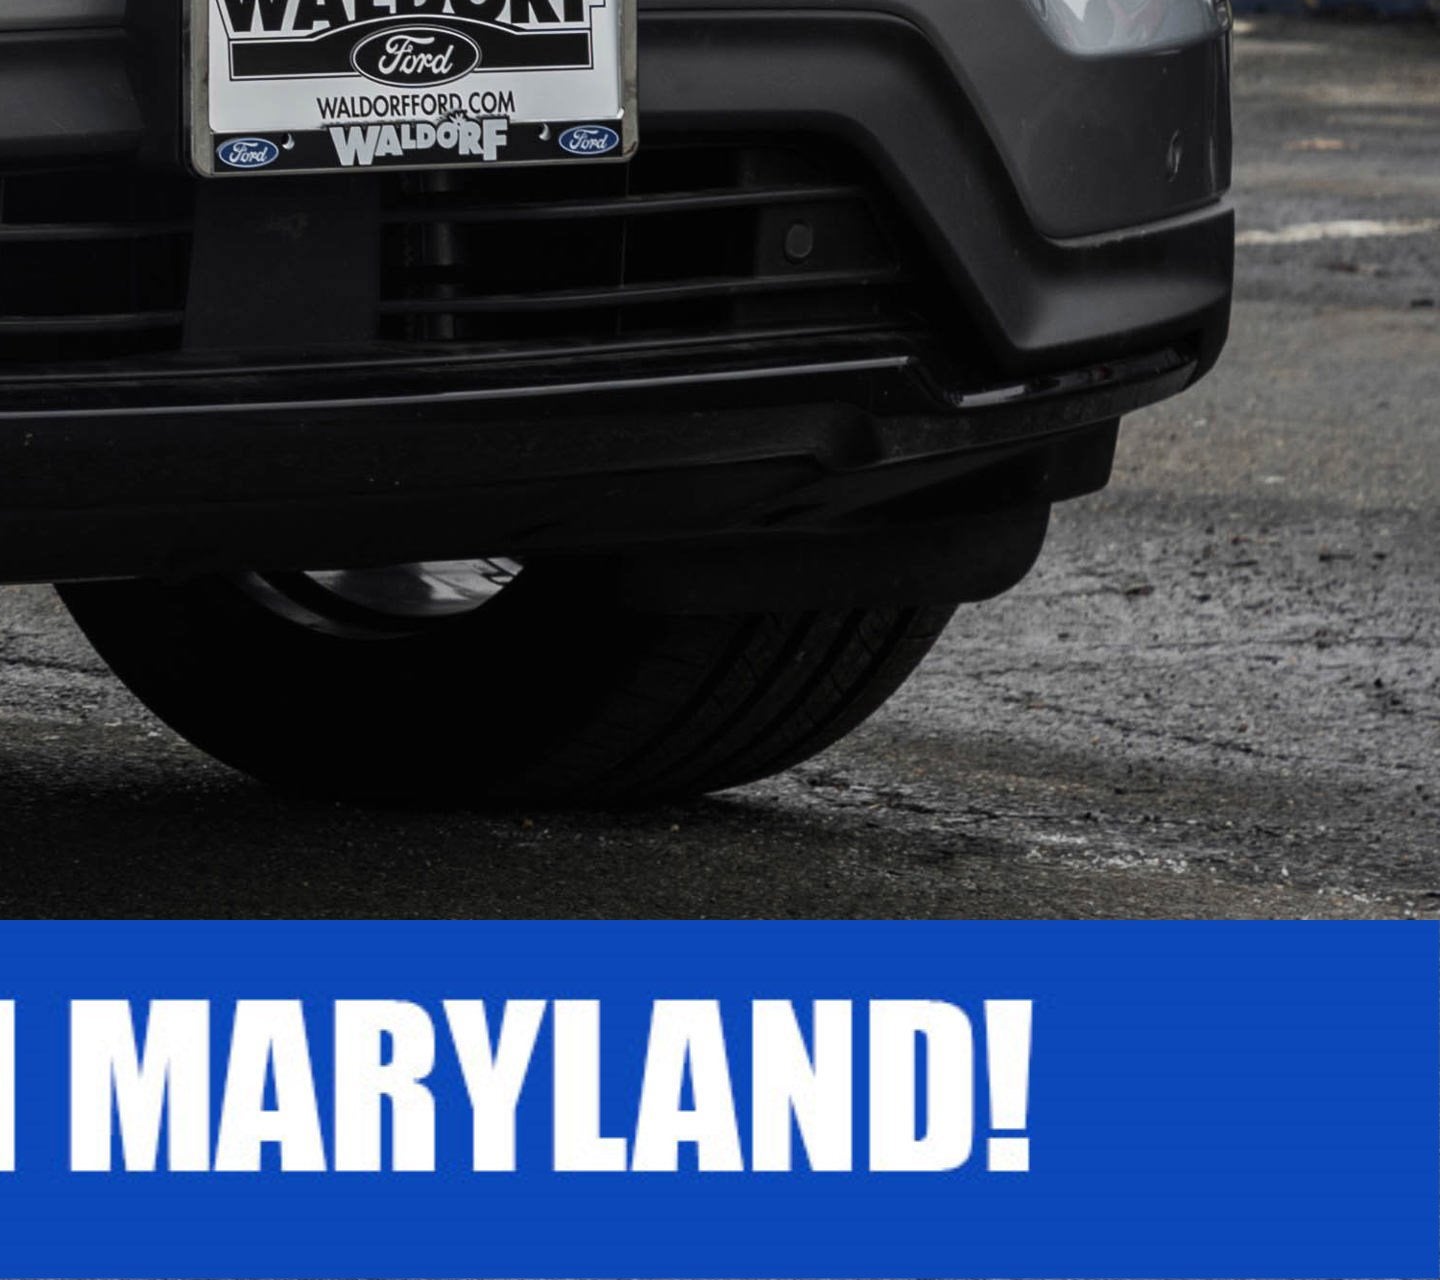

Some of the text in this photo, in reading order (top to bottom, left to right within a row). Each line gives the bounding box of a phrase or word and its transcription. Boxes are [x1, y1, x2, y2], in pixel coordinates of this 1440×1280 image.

[378, 34, 454, 77] Ford
[227, 141, 271, 165] Ford
[328, 116, 510, 167] WALDORF
[567, 127, 612, 151] Ford
